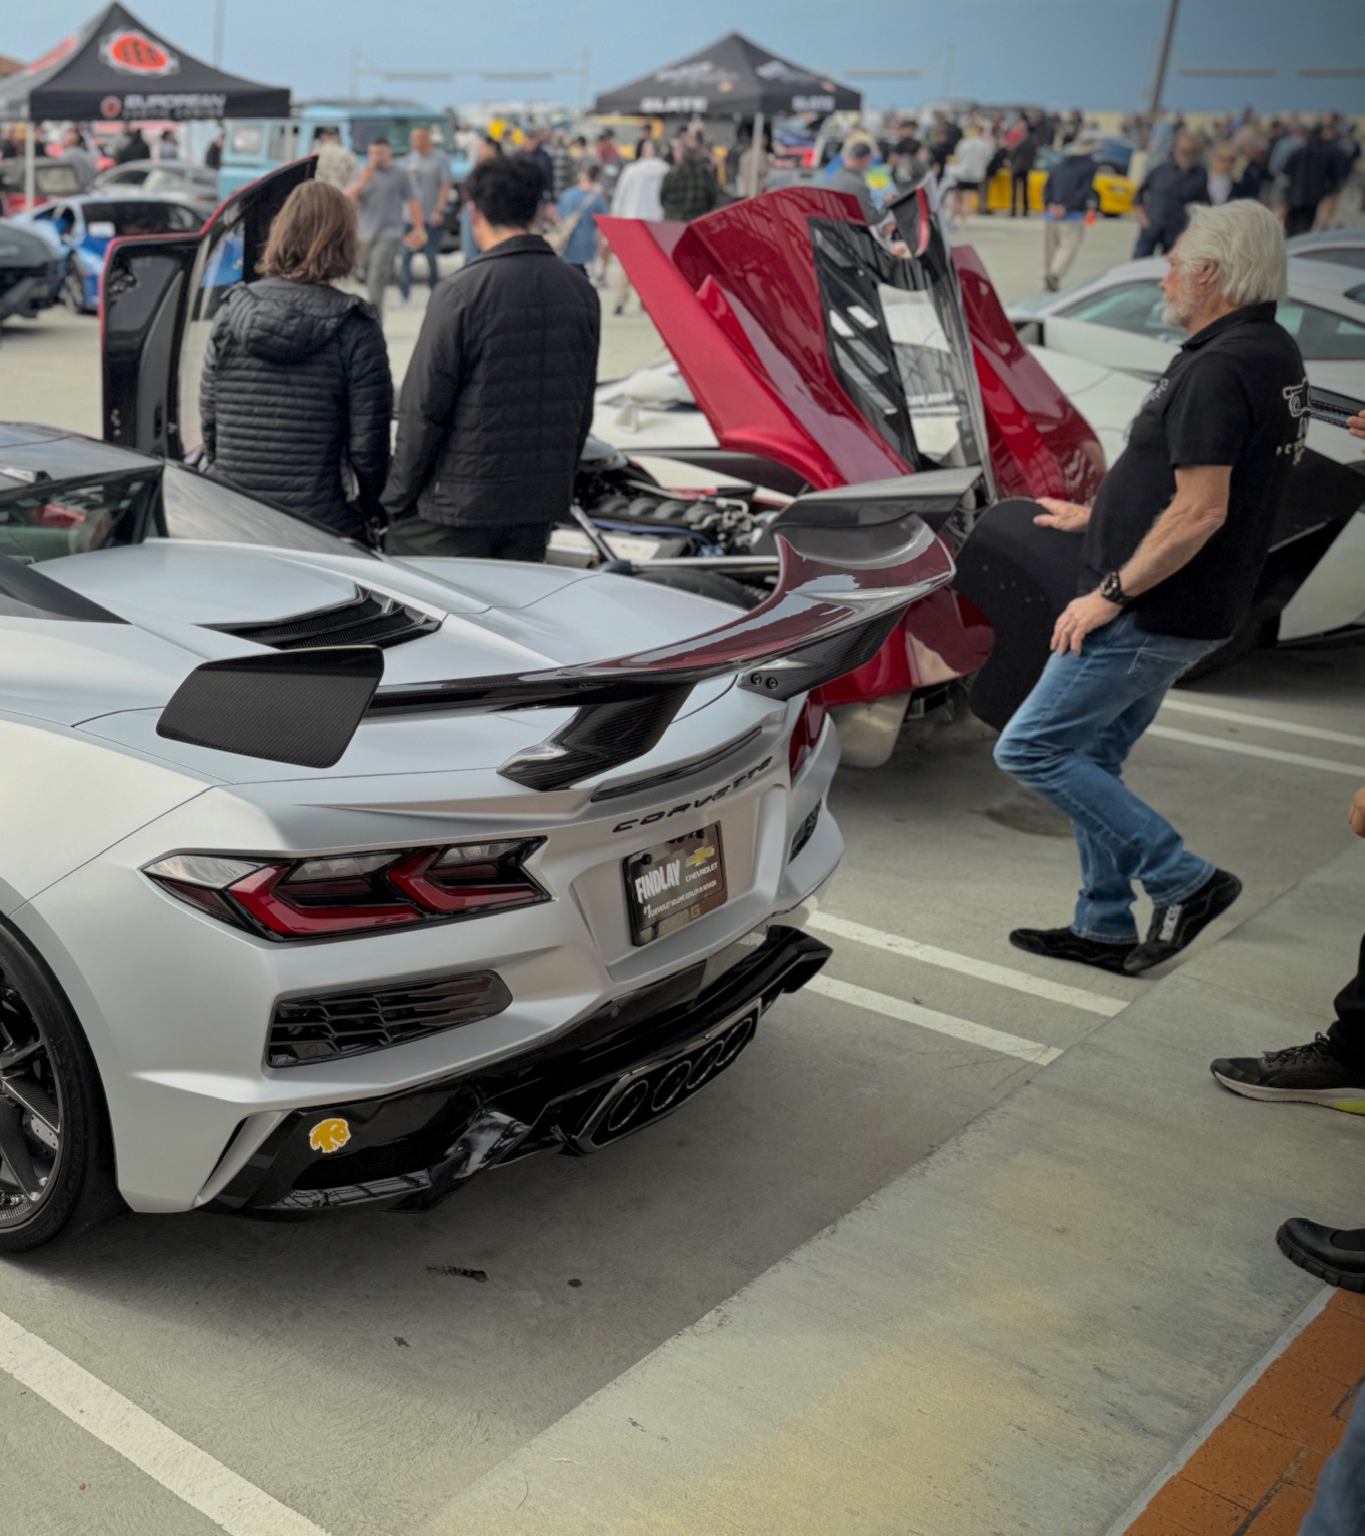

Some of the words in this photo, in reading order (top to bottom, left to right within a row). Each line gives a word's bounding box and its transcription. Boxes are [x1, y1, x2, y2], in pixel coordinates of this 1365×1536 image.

[612, 756, 774, 833] CORVETTE
[635, 859, 681, 905] FINDLAY
[685, 862, 718, 882] CHEVROLET
